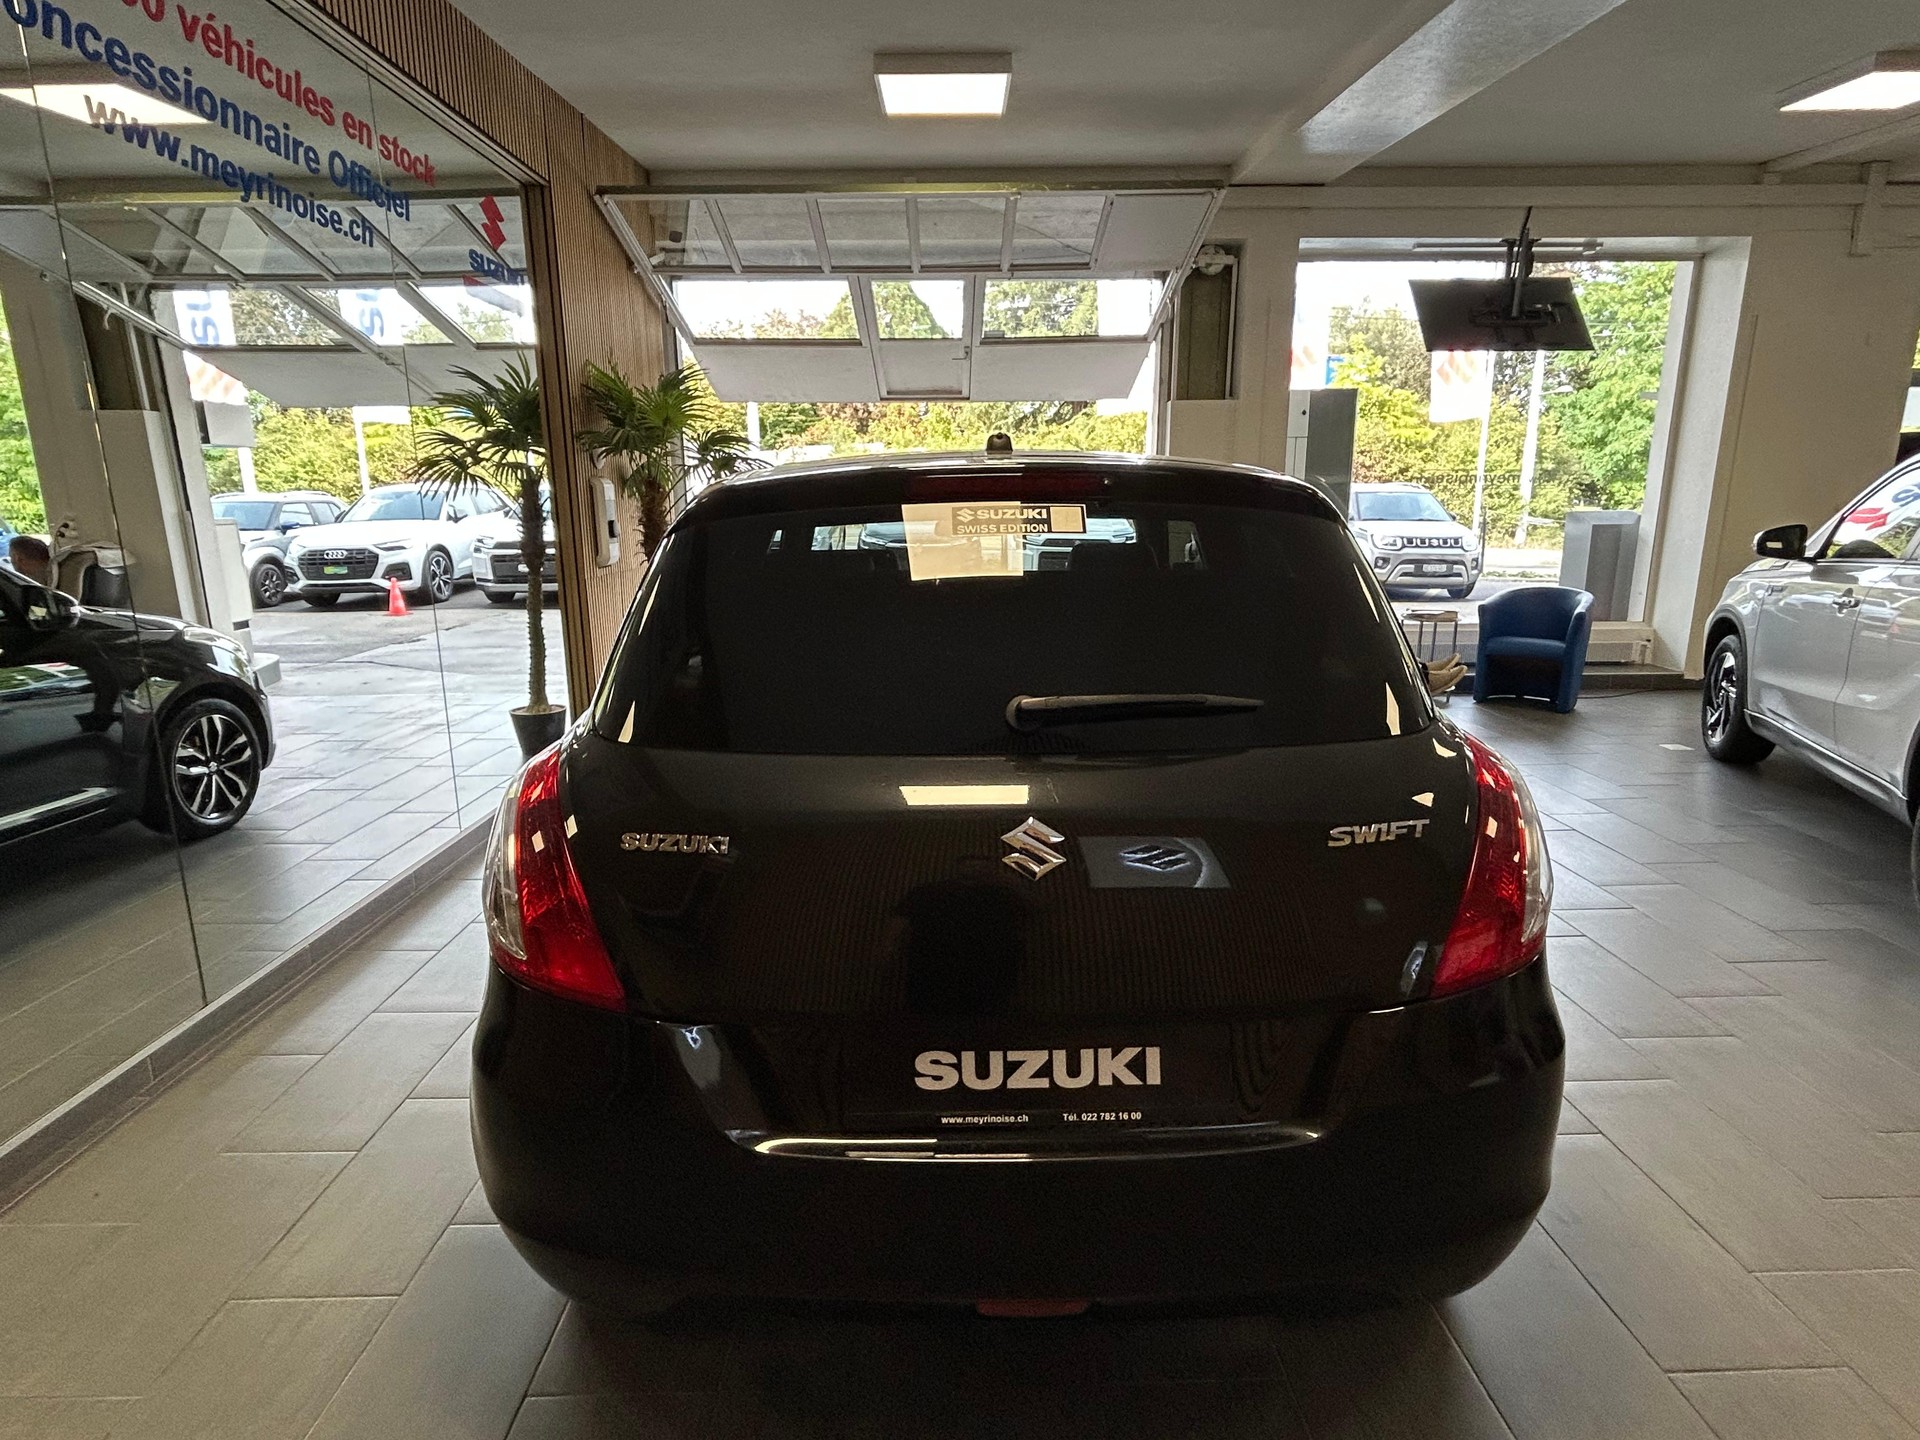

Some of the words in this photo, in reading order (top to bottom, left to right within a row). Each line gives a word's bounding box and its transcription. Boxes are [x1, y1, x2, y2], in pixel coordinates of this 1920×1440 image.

[176, 4, 335, 126] véhicules
[342, 111, 373, 150] en
[379, 134, 436, 187] stock
[83, 94, 374, 248] www.meyrinoise.ch
[328, 150, 411, 222] Officiel
[976, 508, 1048, 519] SUZUKI
[957, 524, 997, 534] SWISS
[1000, 523, 1048, 533] EDITION
[620, 832, 730, 854] SUZUKI
[1327, 818, 1430, 847] SWIFT
[914, 1046, 1161, 1091] SUZUKI
[941, 1114, 1029, 1125] www.meyrinoise.ch
[1062, 1113, 1080, 1121] Tél.
[1081, 1112, 1098, 1121] 022
[1099, 1112, 1116, 1121] 782
[1118, 1111, 1129, 1120] 16
[1130, 1111, 1142, 1120] 00
